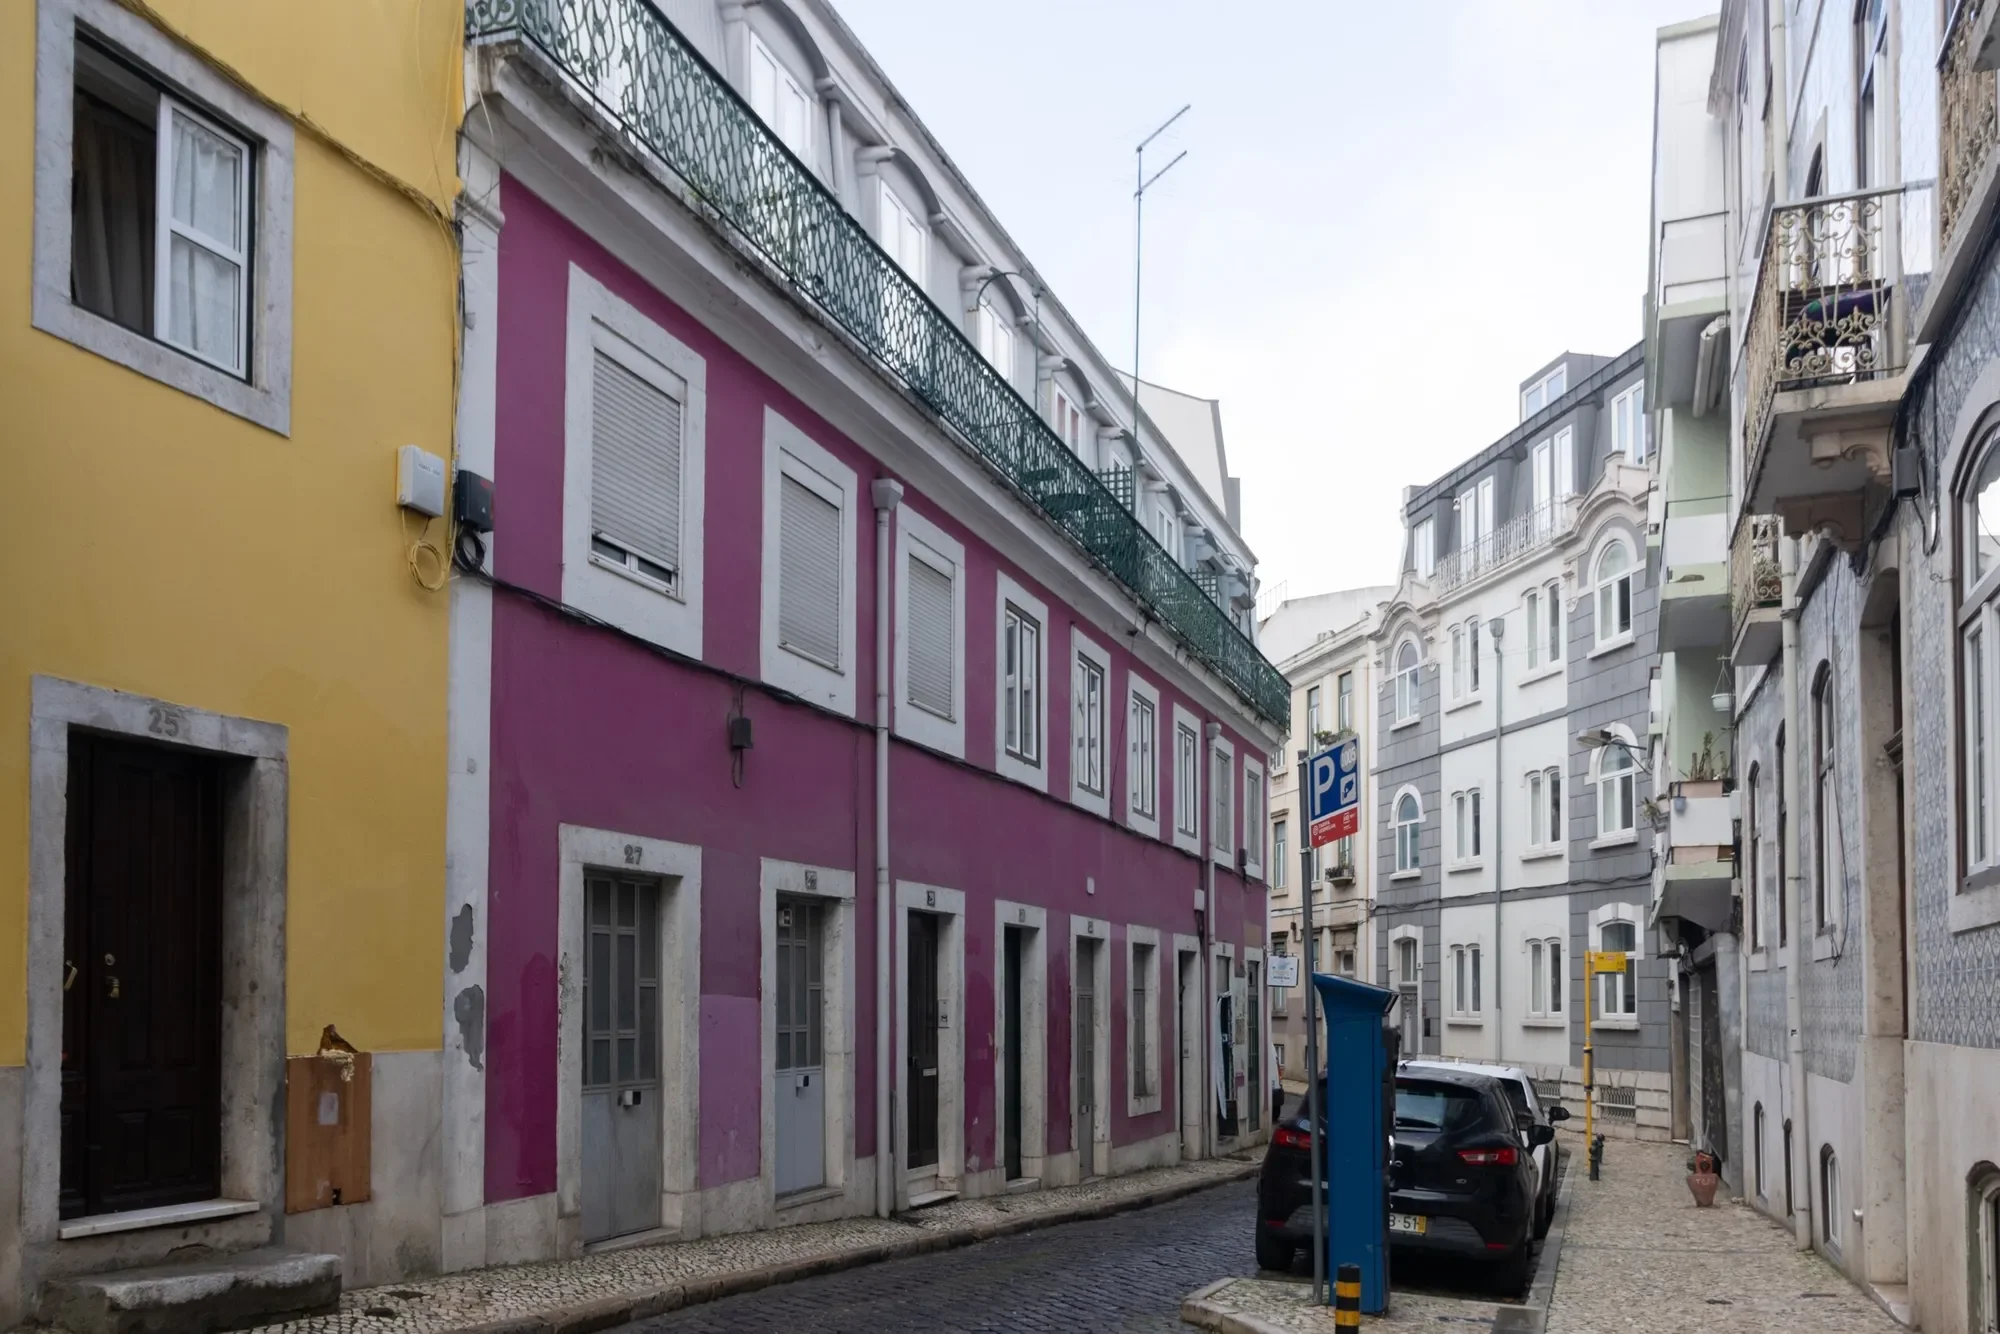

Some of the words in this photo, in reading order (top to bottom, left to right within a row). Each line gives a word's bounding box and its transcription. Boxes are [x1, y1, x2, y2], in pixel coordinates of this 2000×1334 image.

[148, 706, 179, 737] 25
[1314, 756, 1335, 816] P
[624, 844, 642, 864] 27
